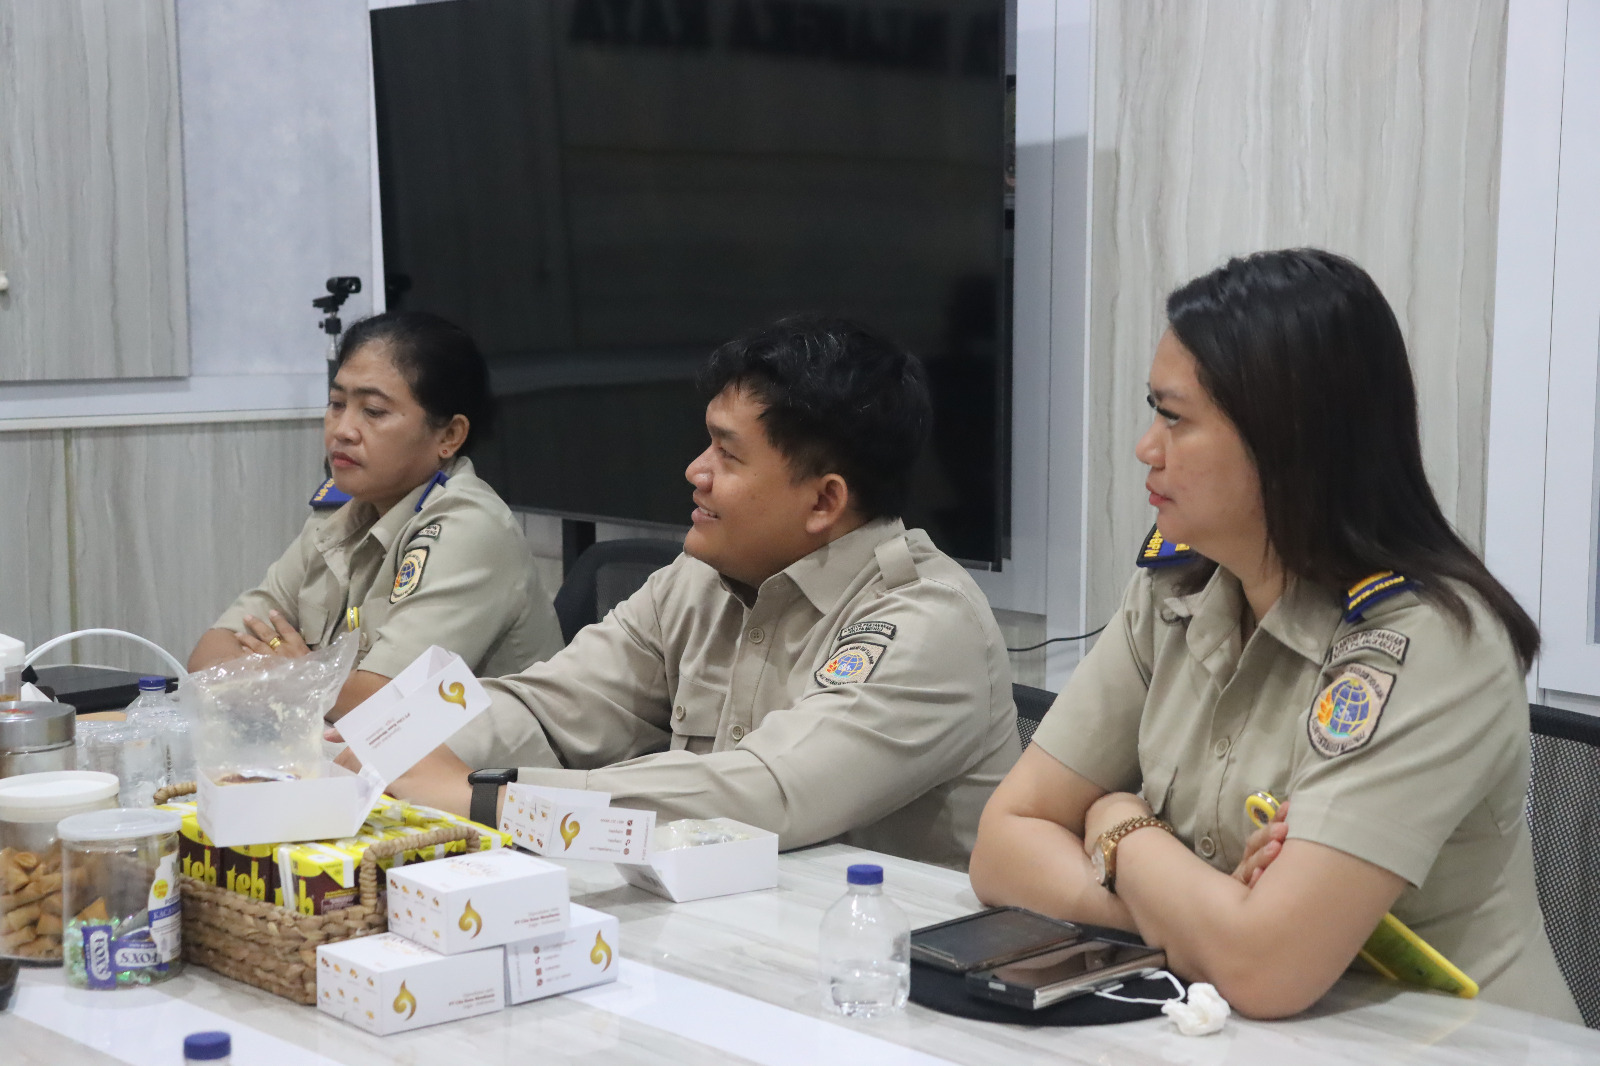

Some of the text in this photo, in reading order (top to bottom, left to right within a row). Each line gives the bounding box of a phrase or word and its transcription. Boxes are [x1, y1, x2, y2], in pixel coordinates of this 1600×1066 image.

[182, 849, 217, 886] teh
[226, 861, 265, 901] teh
[275, 880, 314, 916] th
